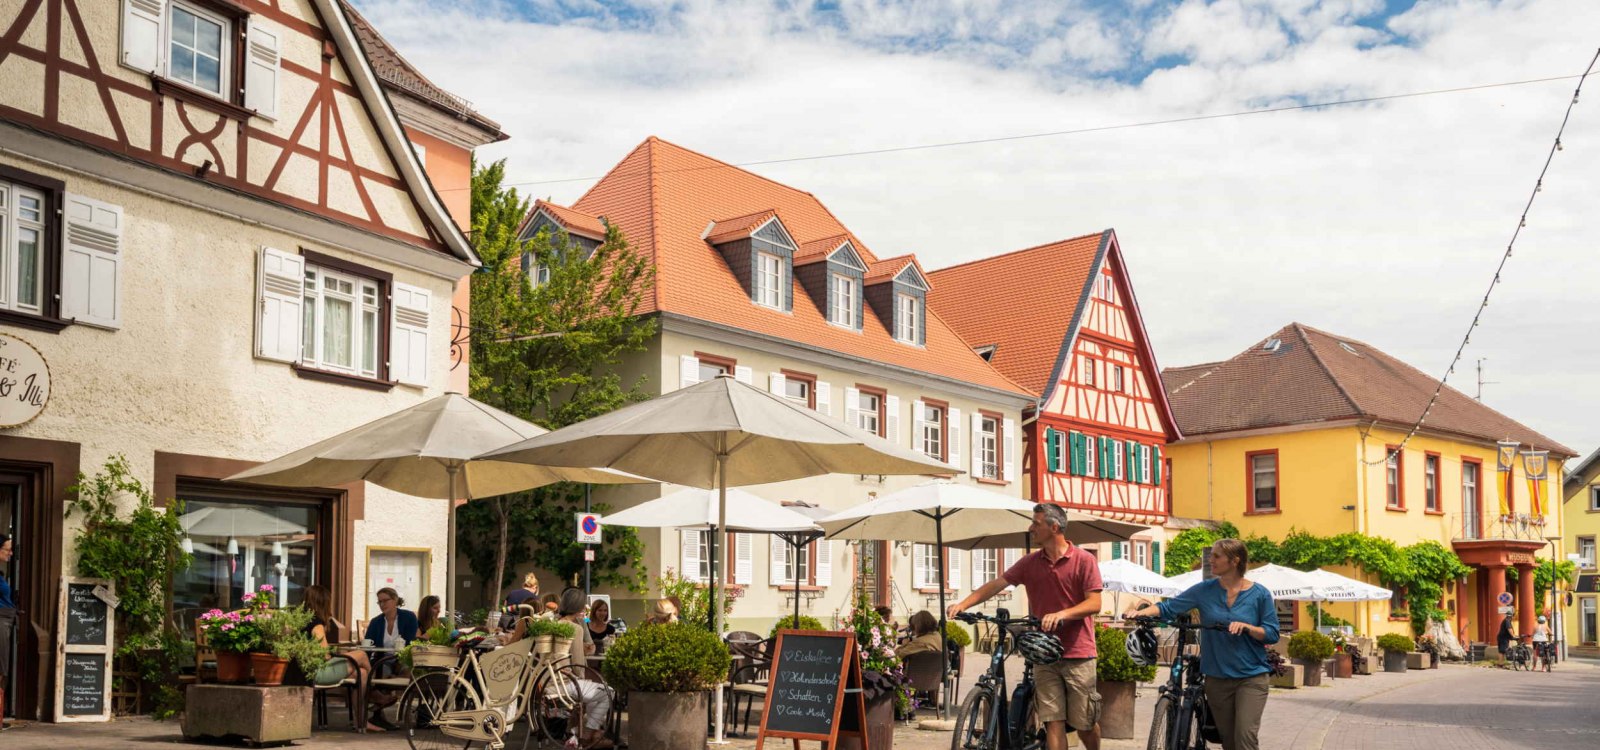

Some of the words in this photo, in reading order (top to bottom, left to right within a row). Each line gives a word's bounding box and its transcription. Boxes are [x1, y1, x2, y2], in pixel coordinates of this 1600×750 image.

[1138, 586, 1163, 595] VELTINS
[1272, 588, 1301, 597] VELTINS
[794, 649, 832, 665] Eiskaffee
[787, 688, 822, 703] Schatten
[805, 707, 826, 719] Musik
